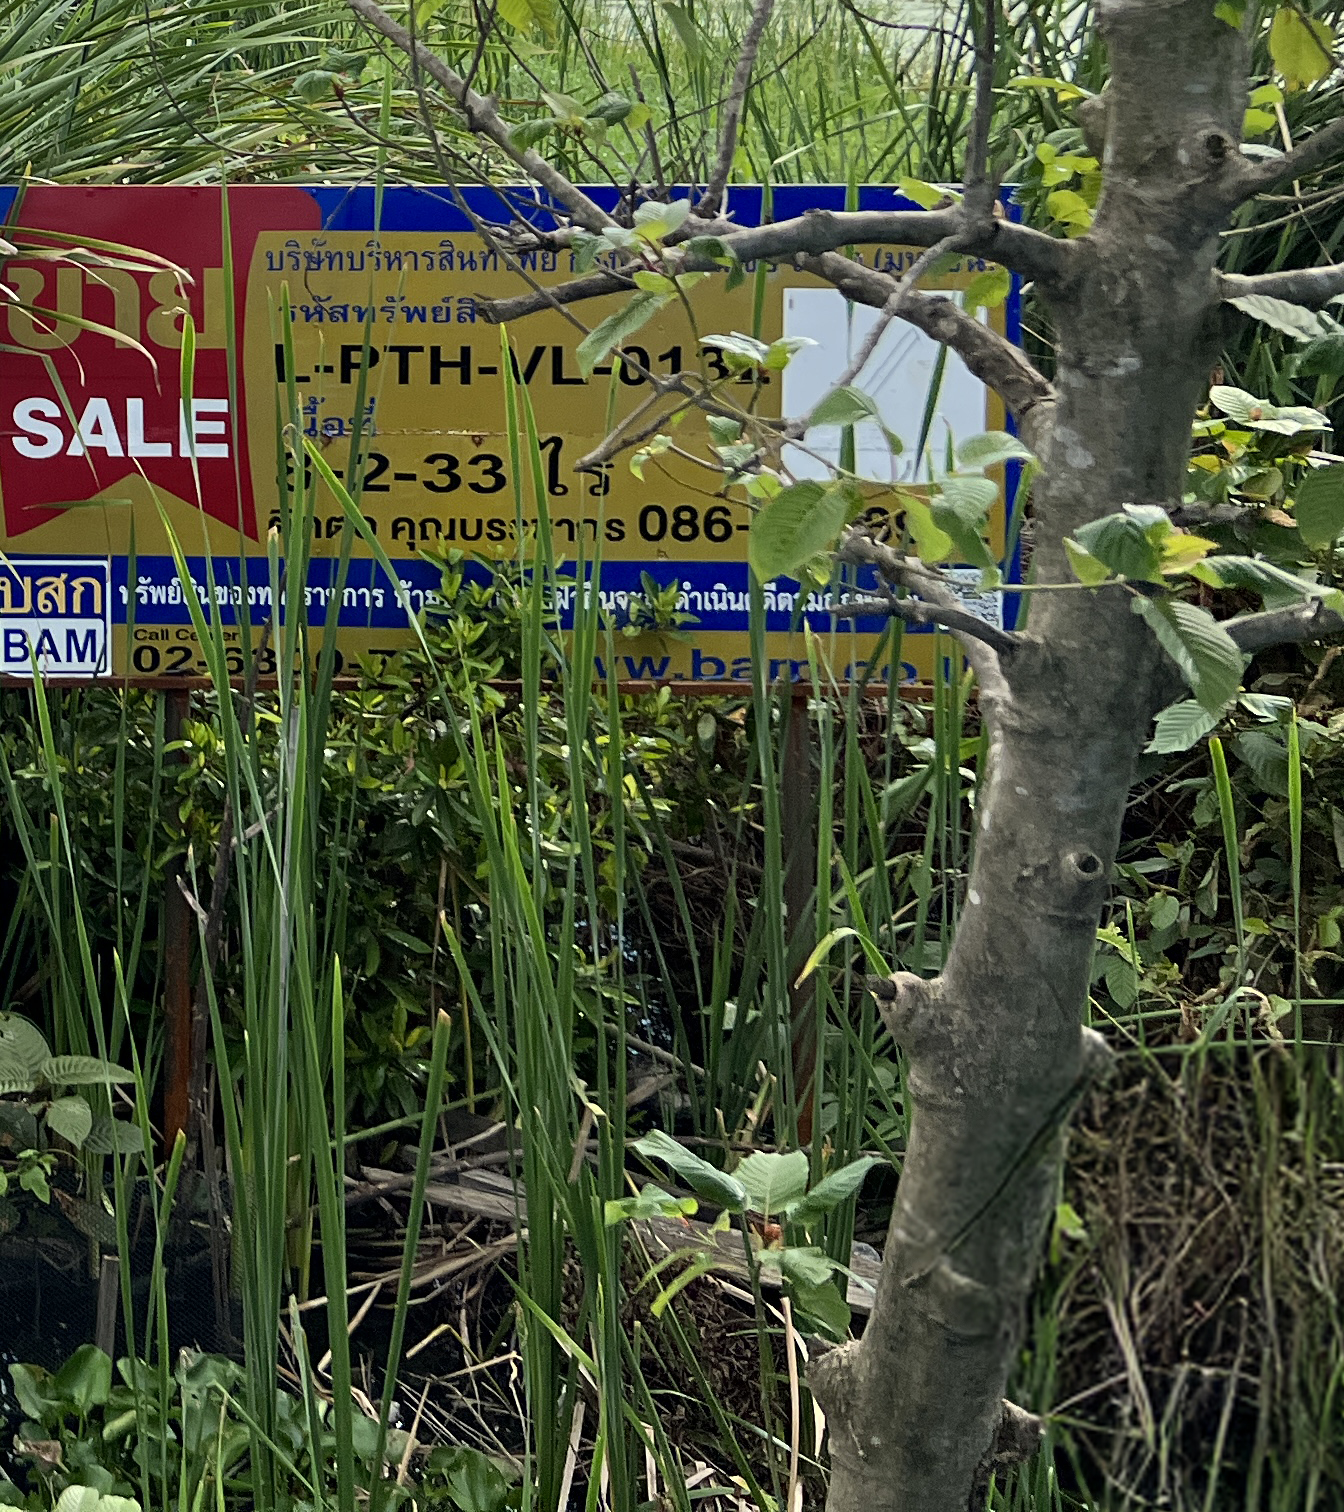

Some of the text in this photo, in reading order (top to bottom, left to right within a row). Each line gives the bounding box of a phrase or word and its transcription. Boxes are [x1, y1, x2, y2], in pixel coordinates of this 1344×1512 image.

[7, 267, 230, 349] ขาย
[275, 343, 772, 386] L-PTH-VL-013
[11, 396, 230, 459] SALE
[3, 628, 97, 663] BAM
[133, 628, 241, 642] Call Ceer
